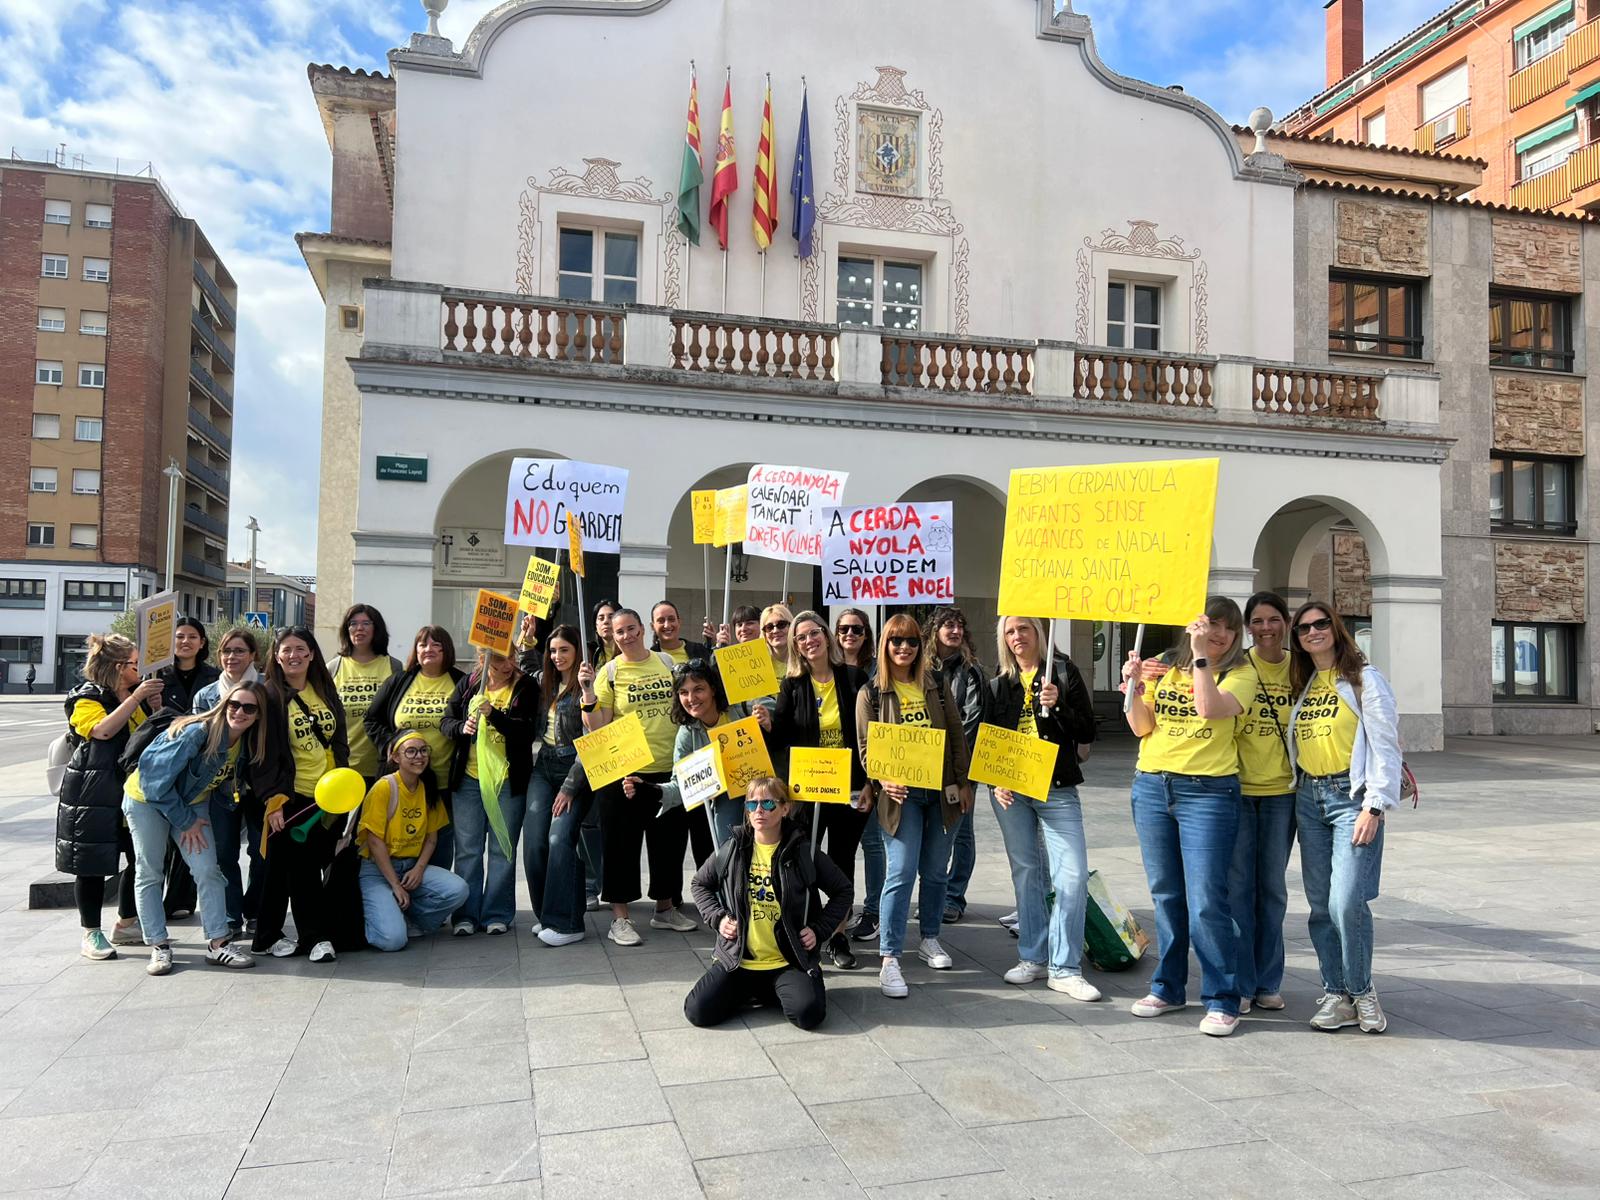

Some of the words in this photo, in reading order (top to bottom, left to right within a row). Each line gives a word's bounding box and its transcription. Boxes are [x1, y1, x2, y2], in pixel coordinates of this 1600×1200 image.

[523, 463, 620, 502] Eduquem
[751, 467, 761, 482] A
[765, 470, 840, 500] CERDANYOLA
[1018, 473, 1058, 496] EBM
[1069, 467, 1177, 494] CERDANYOLA
[751, 485, 809, 507] CALENDARI
[513, 498, 550, 536] NO
[554, 502, 622, 542] GARDEM
[751, 504, 801, 525] TANCAT
[809, 510, 813, 525] i
[1016, 502, 1081, 524] INFANTS
[1094, 500, 1147, 523] SENSE
[829, 509, 846, 538] A
[750, 526, 779, 552] DRETS
[781, 529, 824, 560] VULNER
[849, 534, 925, 555] NYOLA
[1015, 528, 1084, 549] VACANCES
[1117, 531, 1173, 553] NADAL
[535, 561, 551, 575] SOM
[832, 558, 936, 575] SALUDEM
[1014, 558, 1073, 579] SETMANA
[1080, 557, 1132, 581] SANTA
[532, 584, 542, 594] NO
[825, 581, 848, 599] AL
[851, 575, 899, 600] PARE
[908, 576, 954, 599] NOEL
[488, 597, 508, 611] SOM
[1055, 585, 1093, 614] PER
[487, 619, 500, 629] NO
[722, 645, 752, 662] CUIDEU
[728, 664, 737, 675] A
[749, 657, 766, 670] QUI
[340, 683, 378, 693] escol
[738, 673, 766, 689] CUIDA
[1157, 689, 1195, 705] esc
[401, 705, 446, 714] bress
[736, 728, 748, 737] EL
[872, 724, 894, 740] SOM
[984, 725, 1033, 747] TREBALLEM
[736, 736, 753, 748] 0-3
[980, 738, 998, 749] AMB
[890, 746, 906, 761] NO
[976, 750, 990, 761] NO
[996, 755, 1016, 768] AMB
[587, 757, 618, 779] ATENCIÓ
[683, 763, 713, 790] ATENCIÓ
[983, 763, 1028, 783] MIRACLES
[805, 786, 819, 794] SOUS
[820, 786, 841, 795] DIGNES
